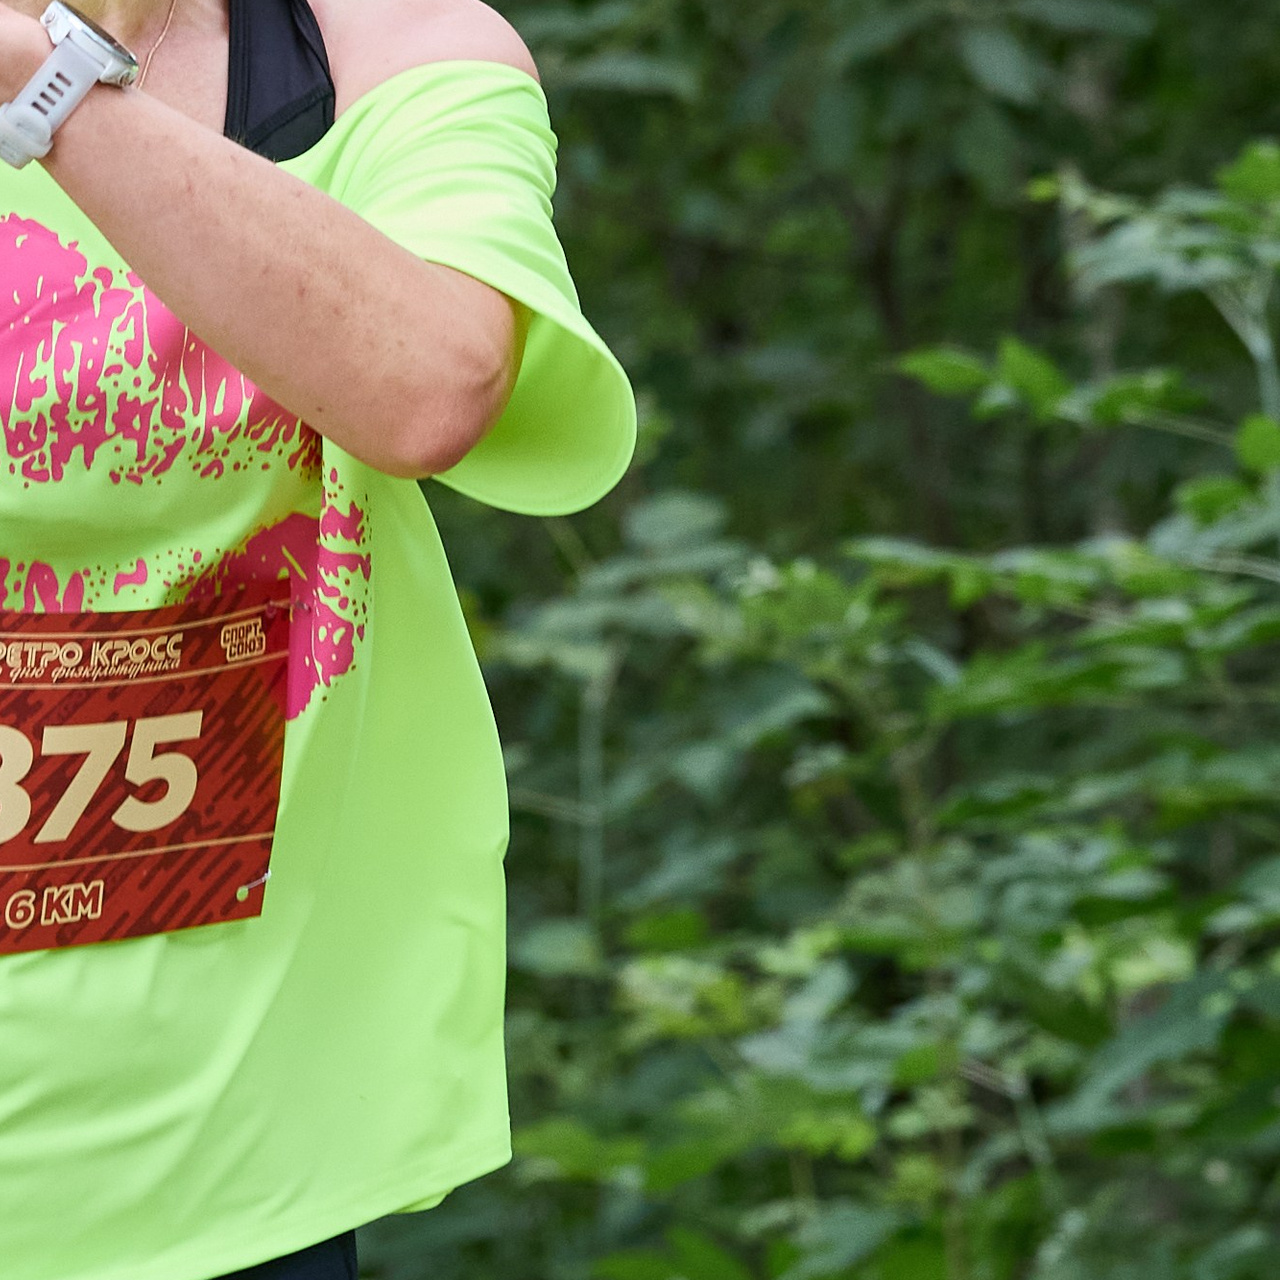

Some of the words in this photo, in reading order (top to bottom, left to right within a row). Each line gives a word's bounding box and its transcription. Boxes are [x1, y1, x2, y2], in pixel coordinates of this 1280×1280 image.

[90, 632, 184, 668] КРОСС
[5, 889, 37, 930] 6
[40, 879, 105, 927] КМ
